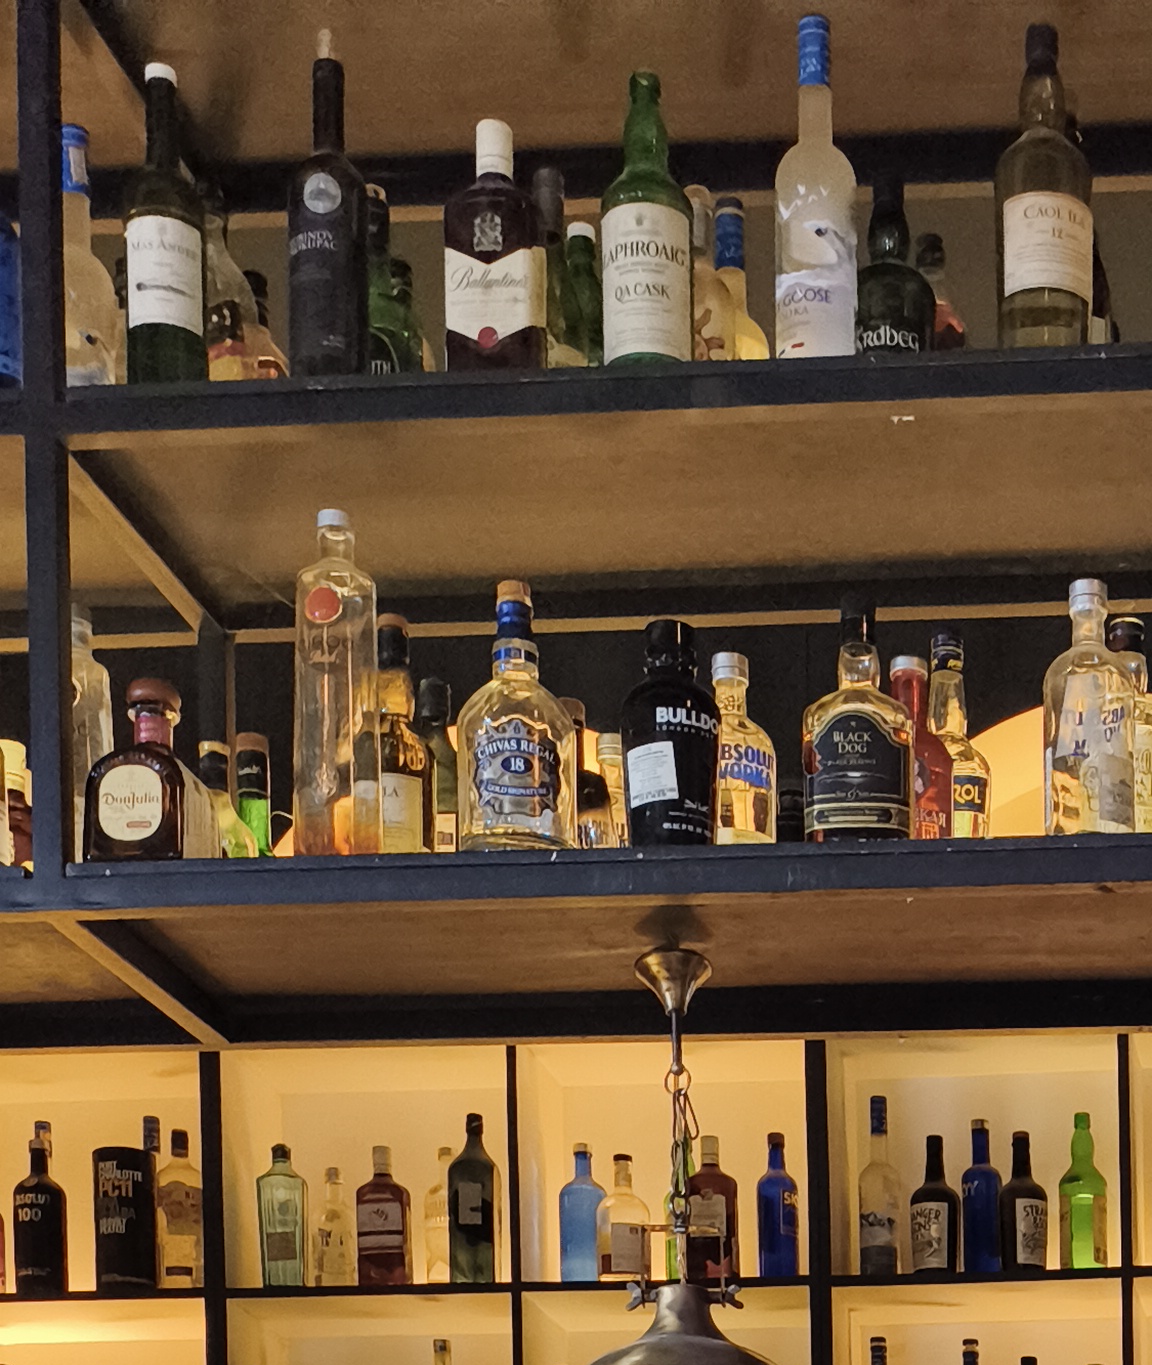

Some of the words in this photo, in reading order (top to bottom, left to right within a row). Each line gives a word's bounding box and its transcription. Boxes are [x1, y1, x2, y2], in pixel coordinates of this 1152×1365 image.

[633, 281, 671, 301] CASK
[833, 731, 872, 743] BLACK
[476, 738, 518, 760] CHIVAS
[519, 739, 556, 765] REGAL
[837, 741, 868, 754] DOG
[720, 743, 775, 769] BSOLUT
[509, 757, 526, 772] 18
[18, 1207, 42, 1222] 100
